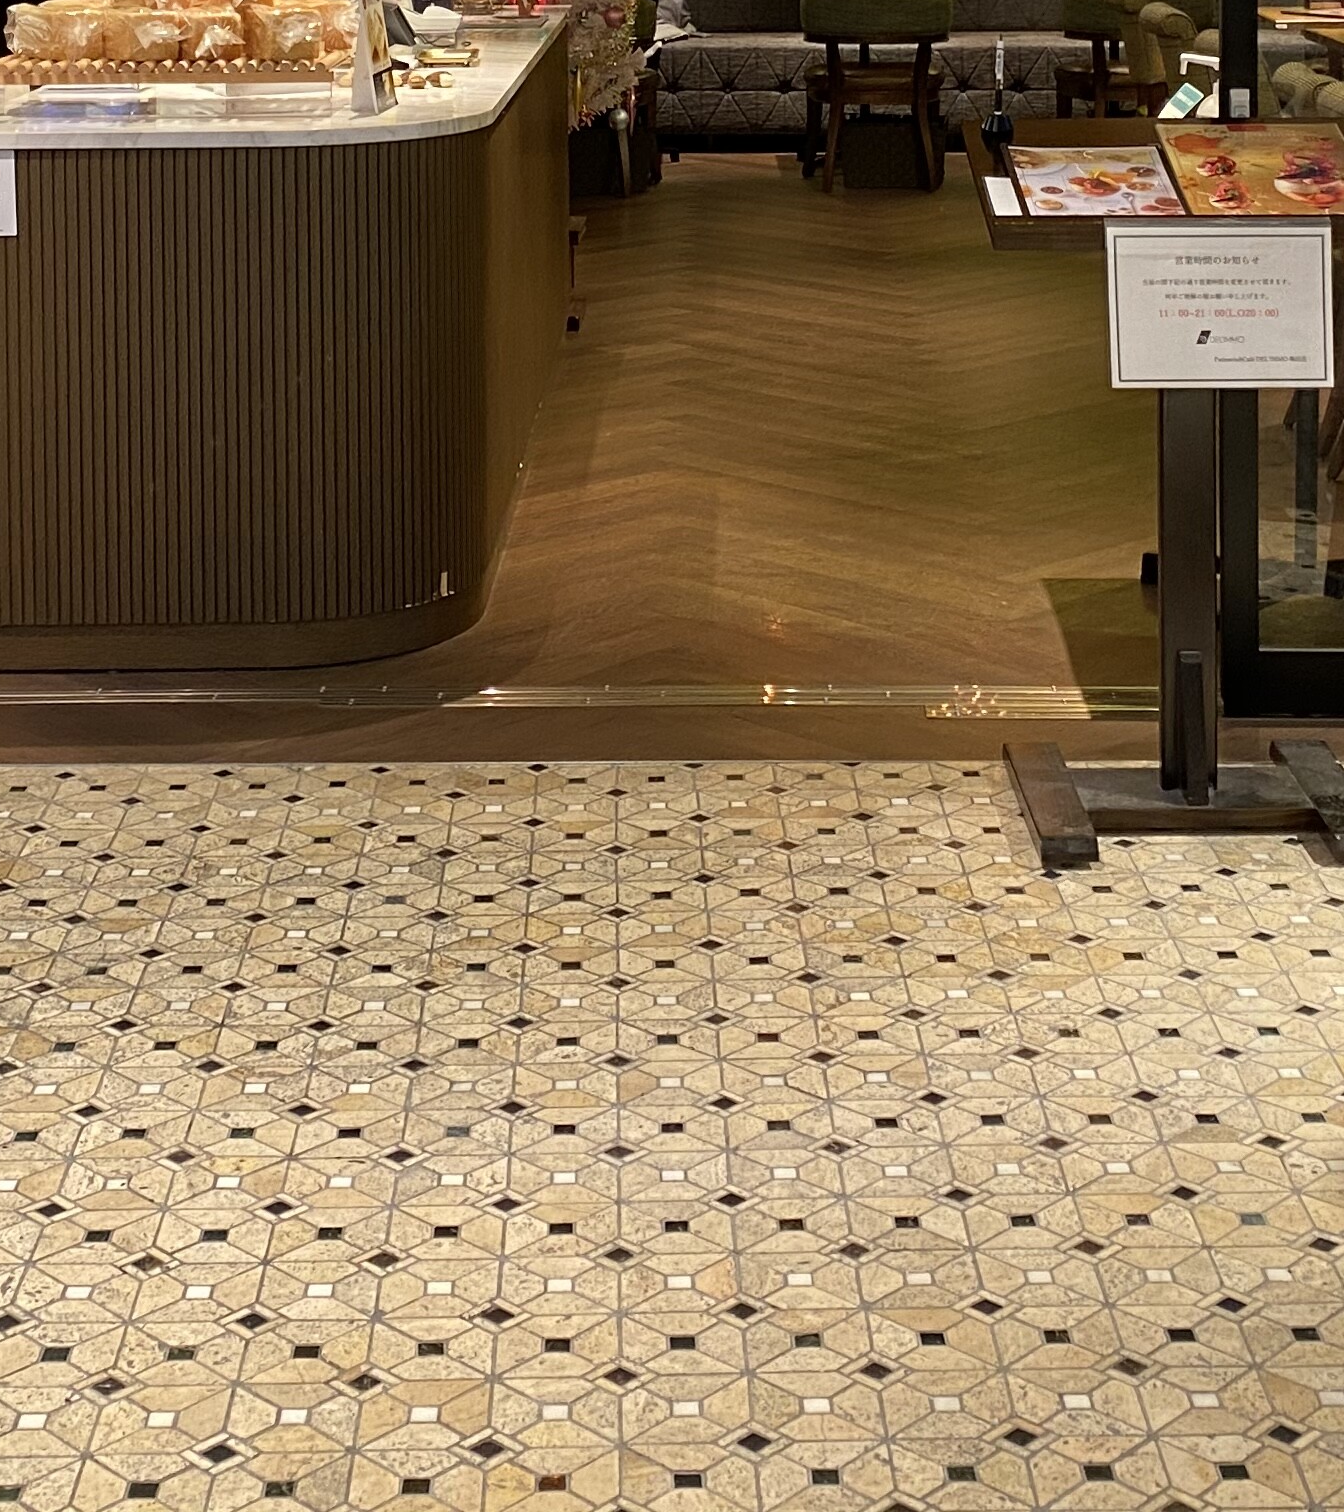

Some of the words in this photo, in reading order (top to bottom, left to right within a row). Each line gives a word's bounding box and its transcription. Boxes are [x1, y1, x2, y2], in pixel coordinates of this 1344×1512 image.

[1175, 255, 1260, 266] 営業時間のお知らせ
